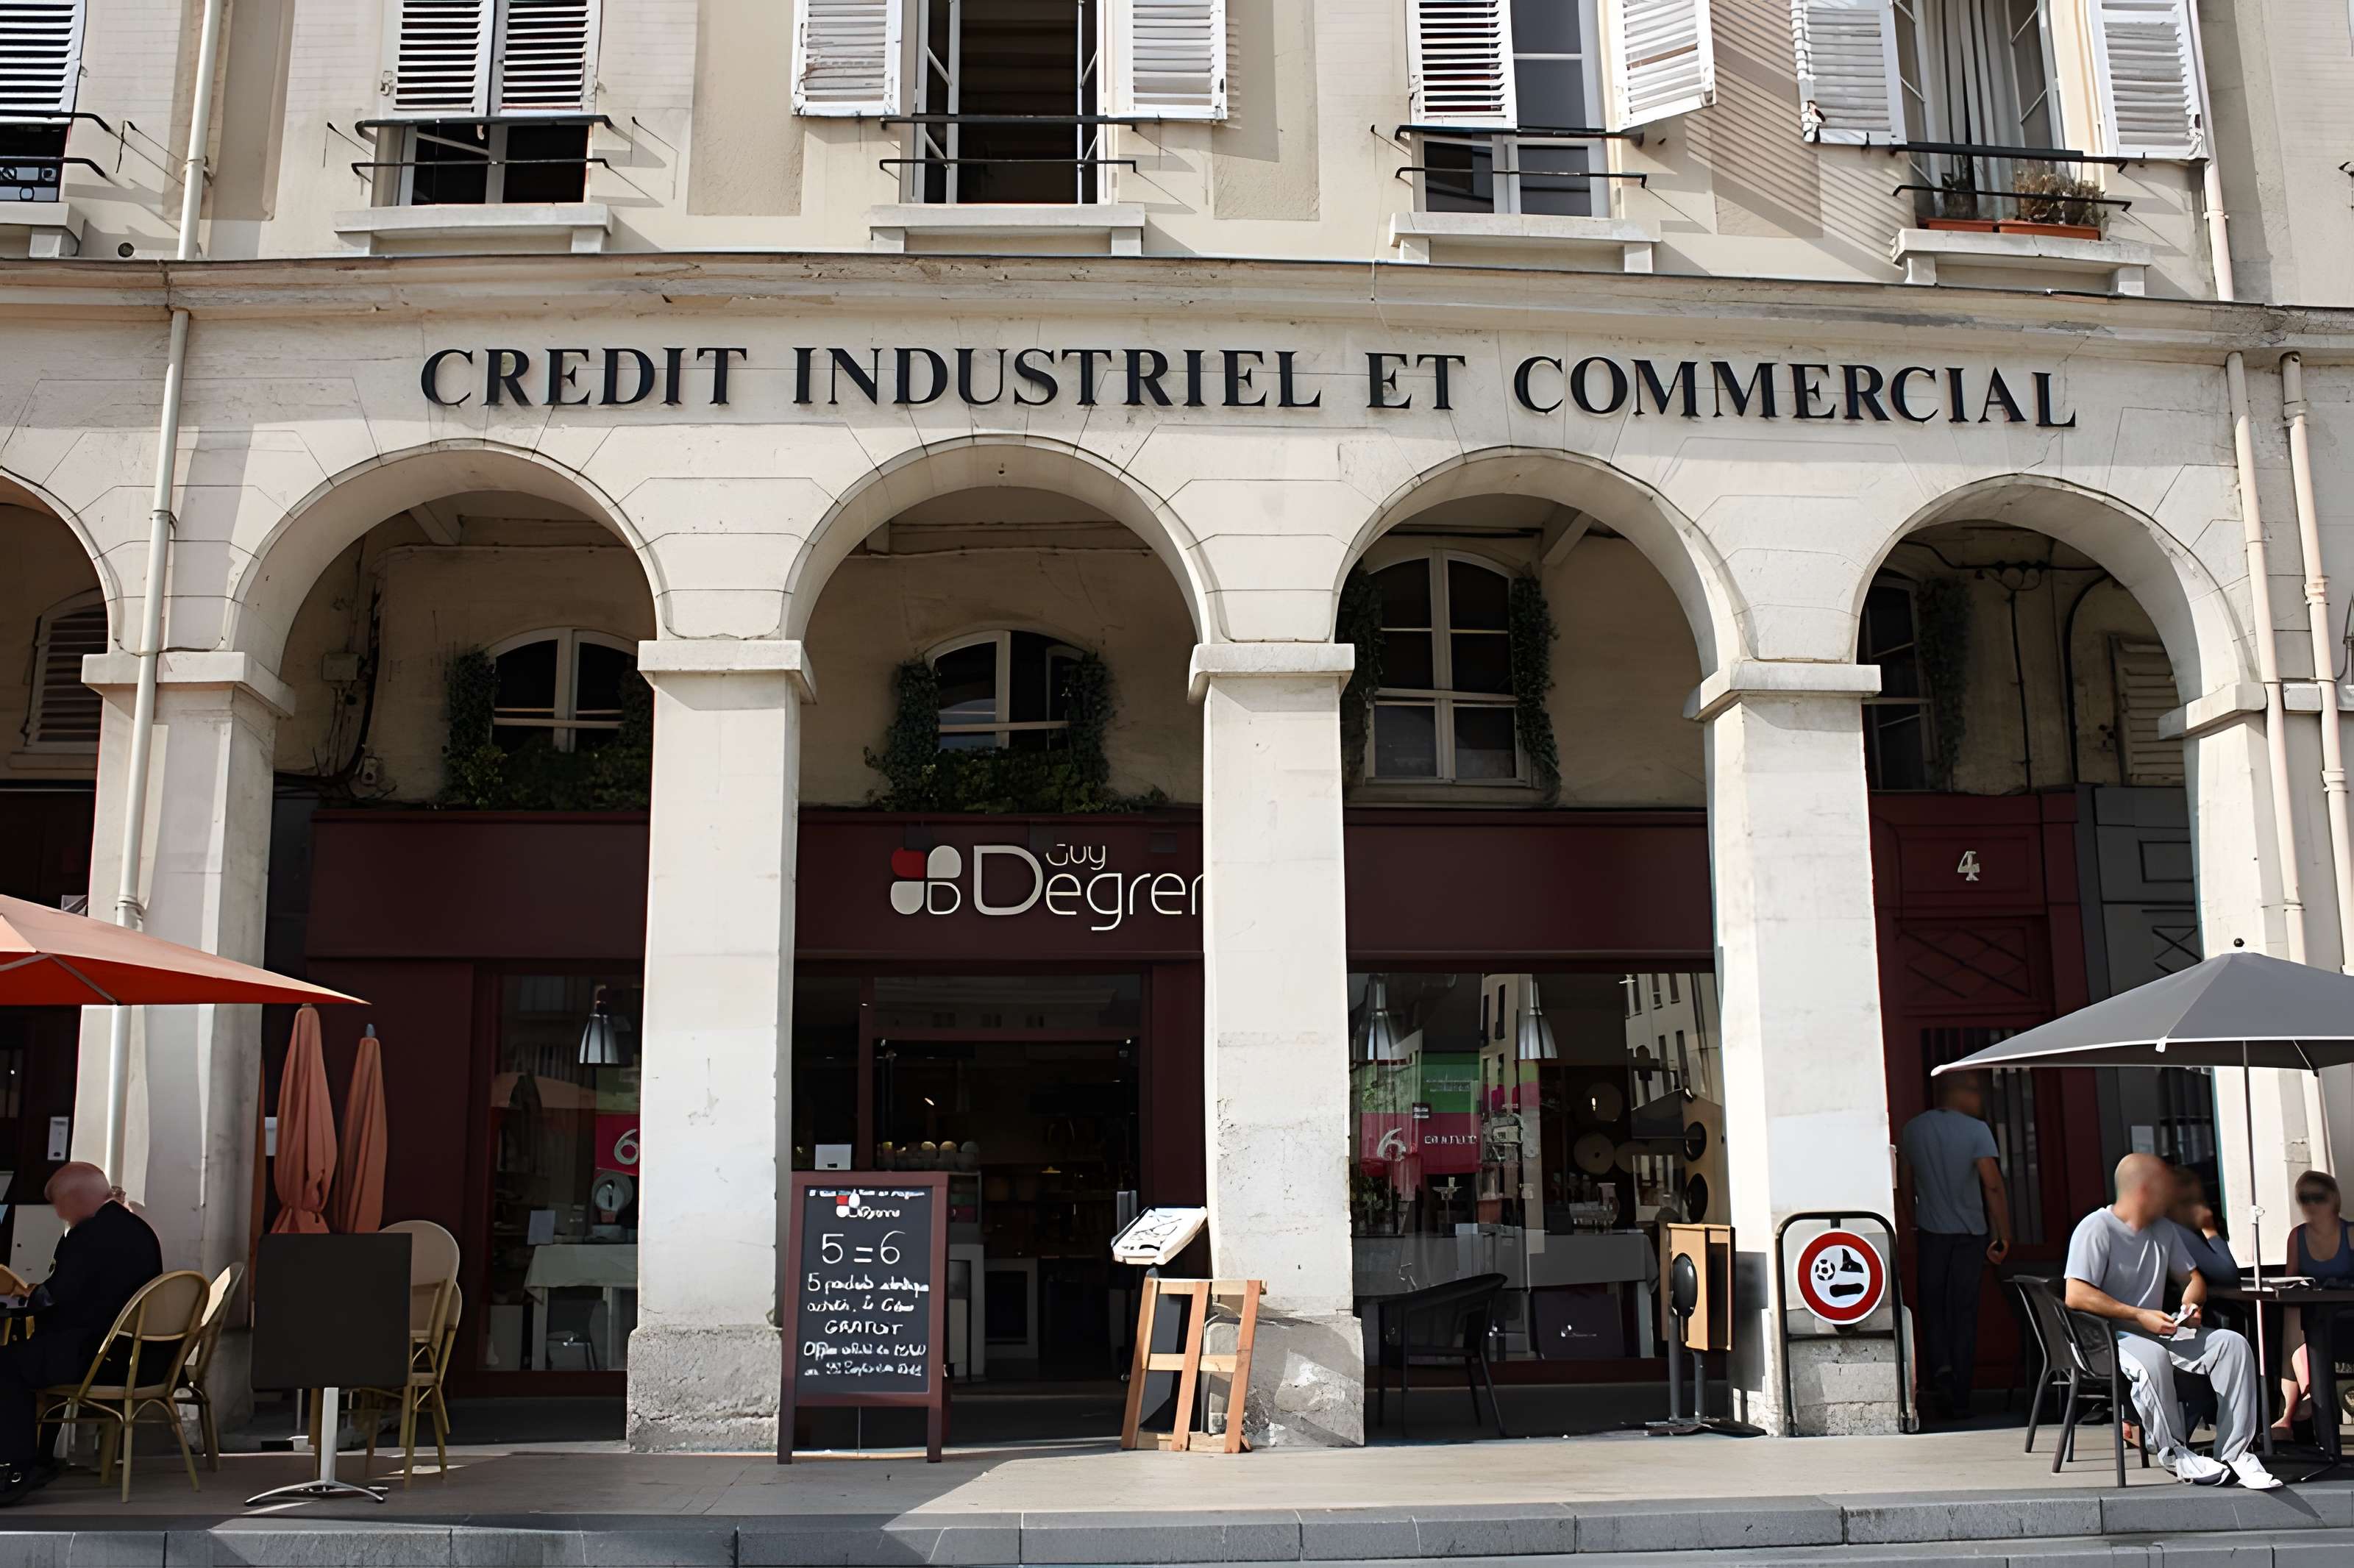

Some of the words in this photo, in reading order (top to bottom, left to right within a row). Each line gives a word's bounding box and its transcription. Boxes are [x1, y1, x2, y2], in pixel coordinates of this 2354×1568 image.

[421, 347, 747, 408] CREDIT
[792, 347, 1321, 408] INDUSTRIEL
[1365, 352, 1467, 410] ET
[1513, 356, 2077, 428] COMMERCIAL
[1045, 844, 1106, 871] Guy
[1957, 850, 1980, 881] 4
[614, 1128, 639, 1165] 6
[808, 1272, 821, 1291] 5
